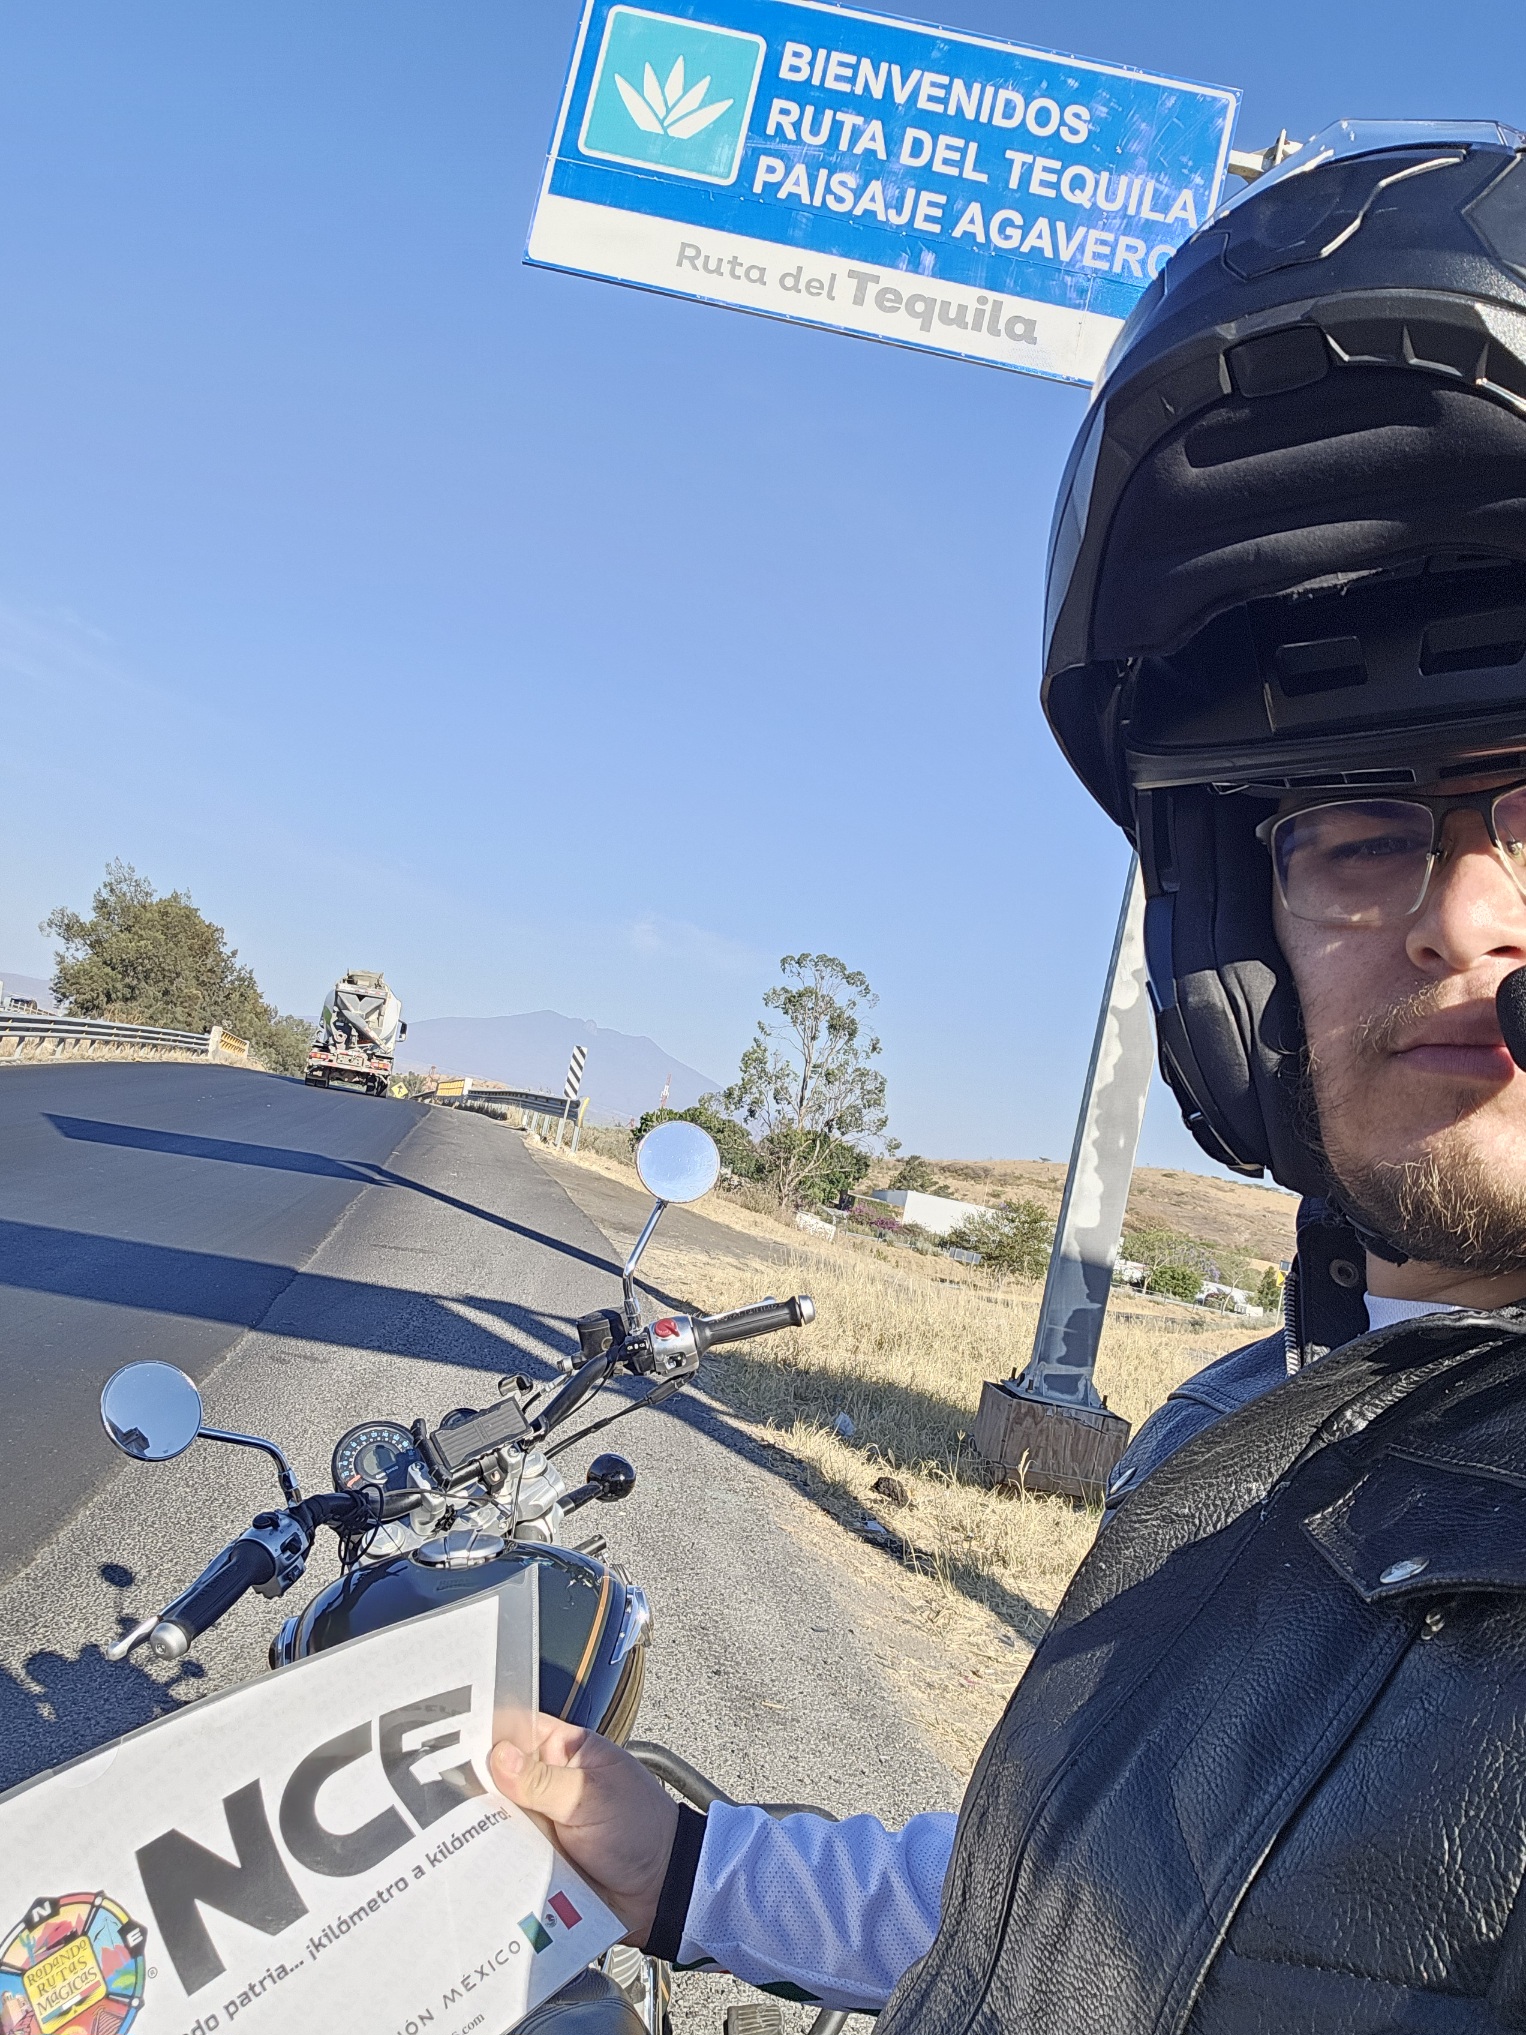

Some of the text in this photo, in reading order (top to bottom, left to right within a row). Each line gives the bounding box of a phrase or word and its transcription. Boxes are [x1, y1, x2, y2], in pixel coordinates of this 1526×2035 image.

[779, 41, 1089, 144] BIENVENIDOS
[753, 155, 947, 234] PAISAJE
[766, 98, 1198, 229] RUTA DEL TEQUILA
[676, 241, 1038, 345] Ruta del Tequila
[135, 1684, 489, 1996] NCE
[222, 1960, 305, 2021] patria...
[306, 1876, 410, 1961] ¡kilómetro
[411, 1864, 426, 1879] a
[425, 1806, 512, 1868] kilómetro!
[442, 1940, 521, 2009] MÉXICO
